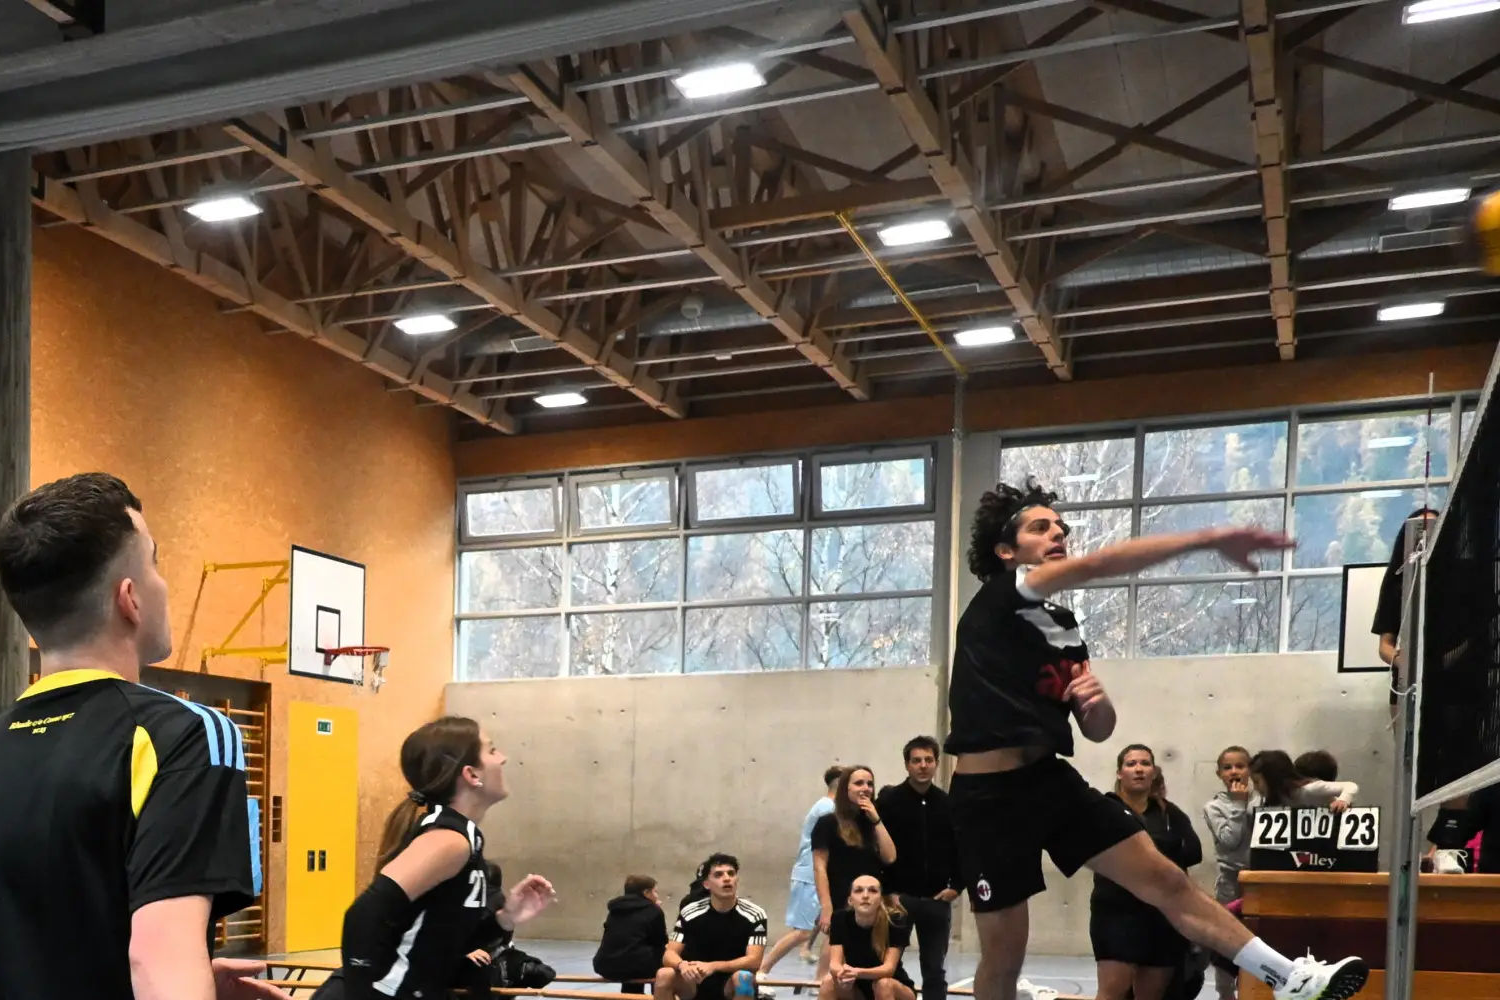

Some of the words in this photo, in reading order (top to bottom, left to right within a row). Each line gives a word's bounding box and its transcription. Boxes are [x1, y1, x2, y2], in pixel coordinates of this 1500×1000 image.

[1258, 812, 1289, 845] 22
[1301, 815, 1312, 837] 0
[1318, 814, 1330, 836] 0
[1345, 812, 1376, 846] 23
